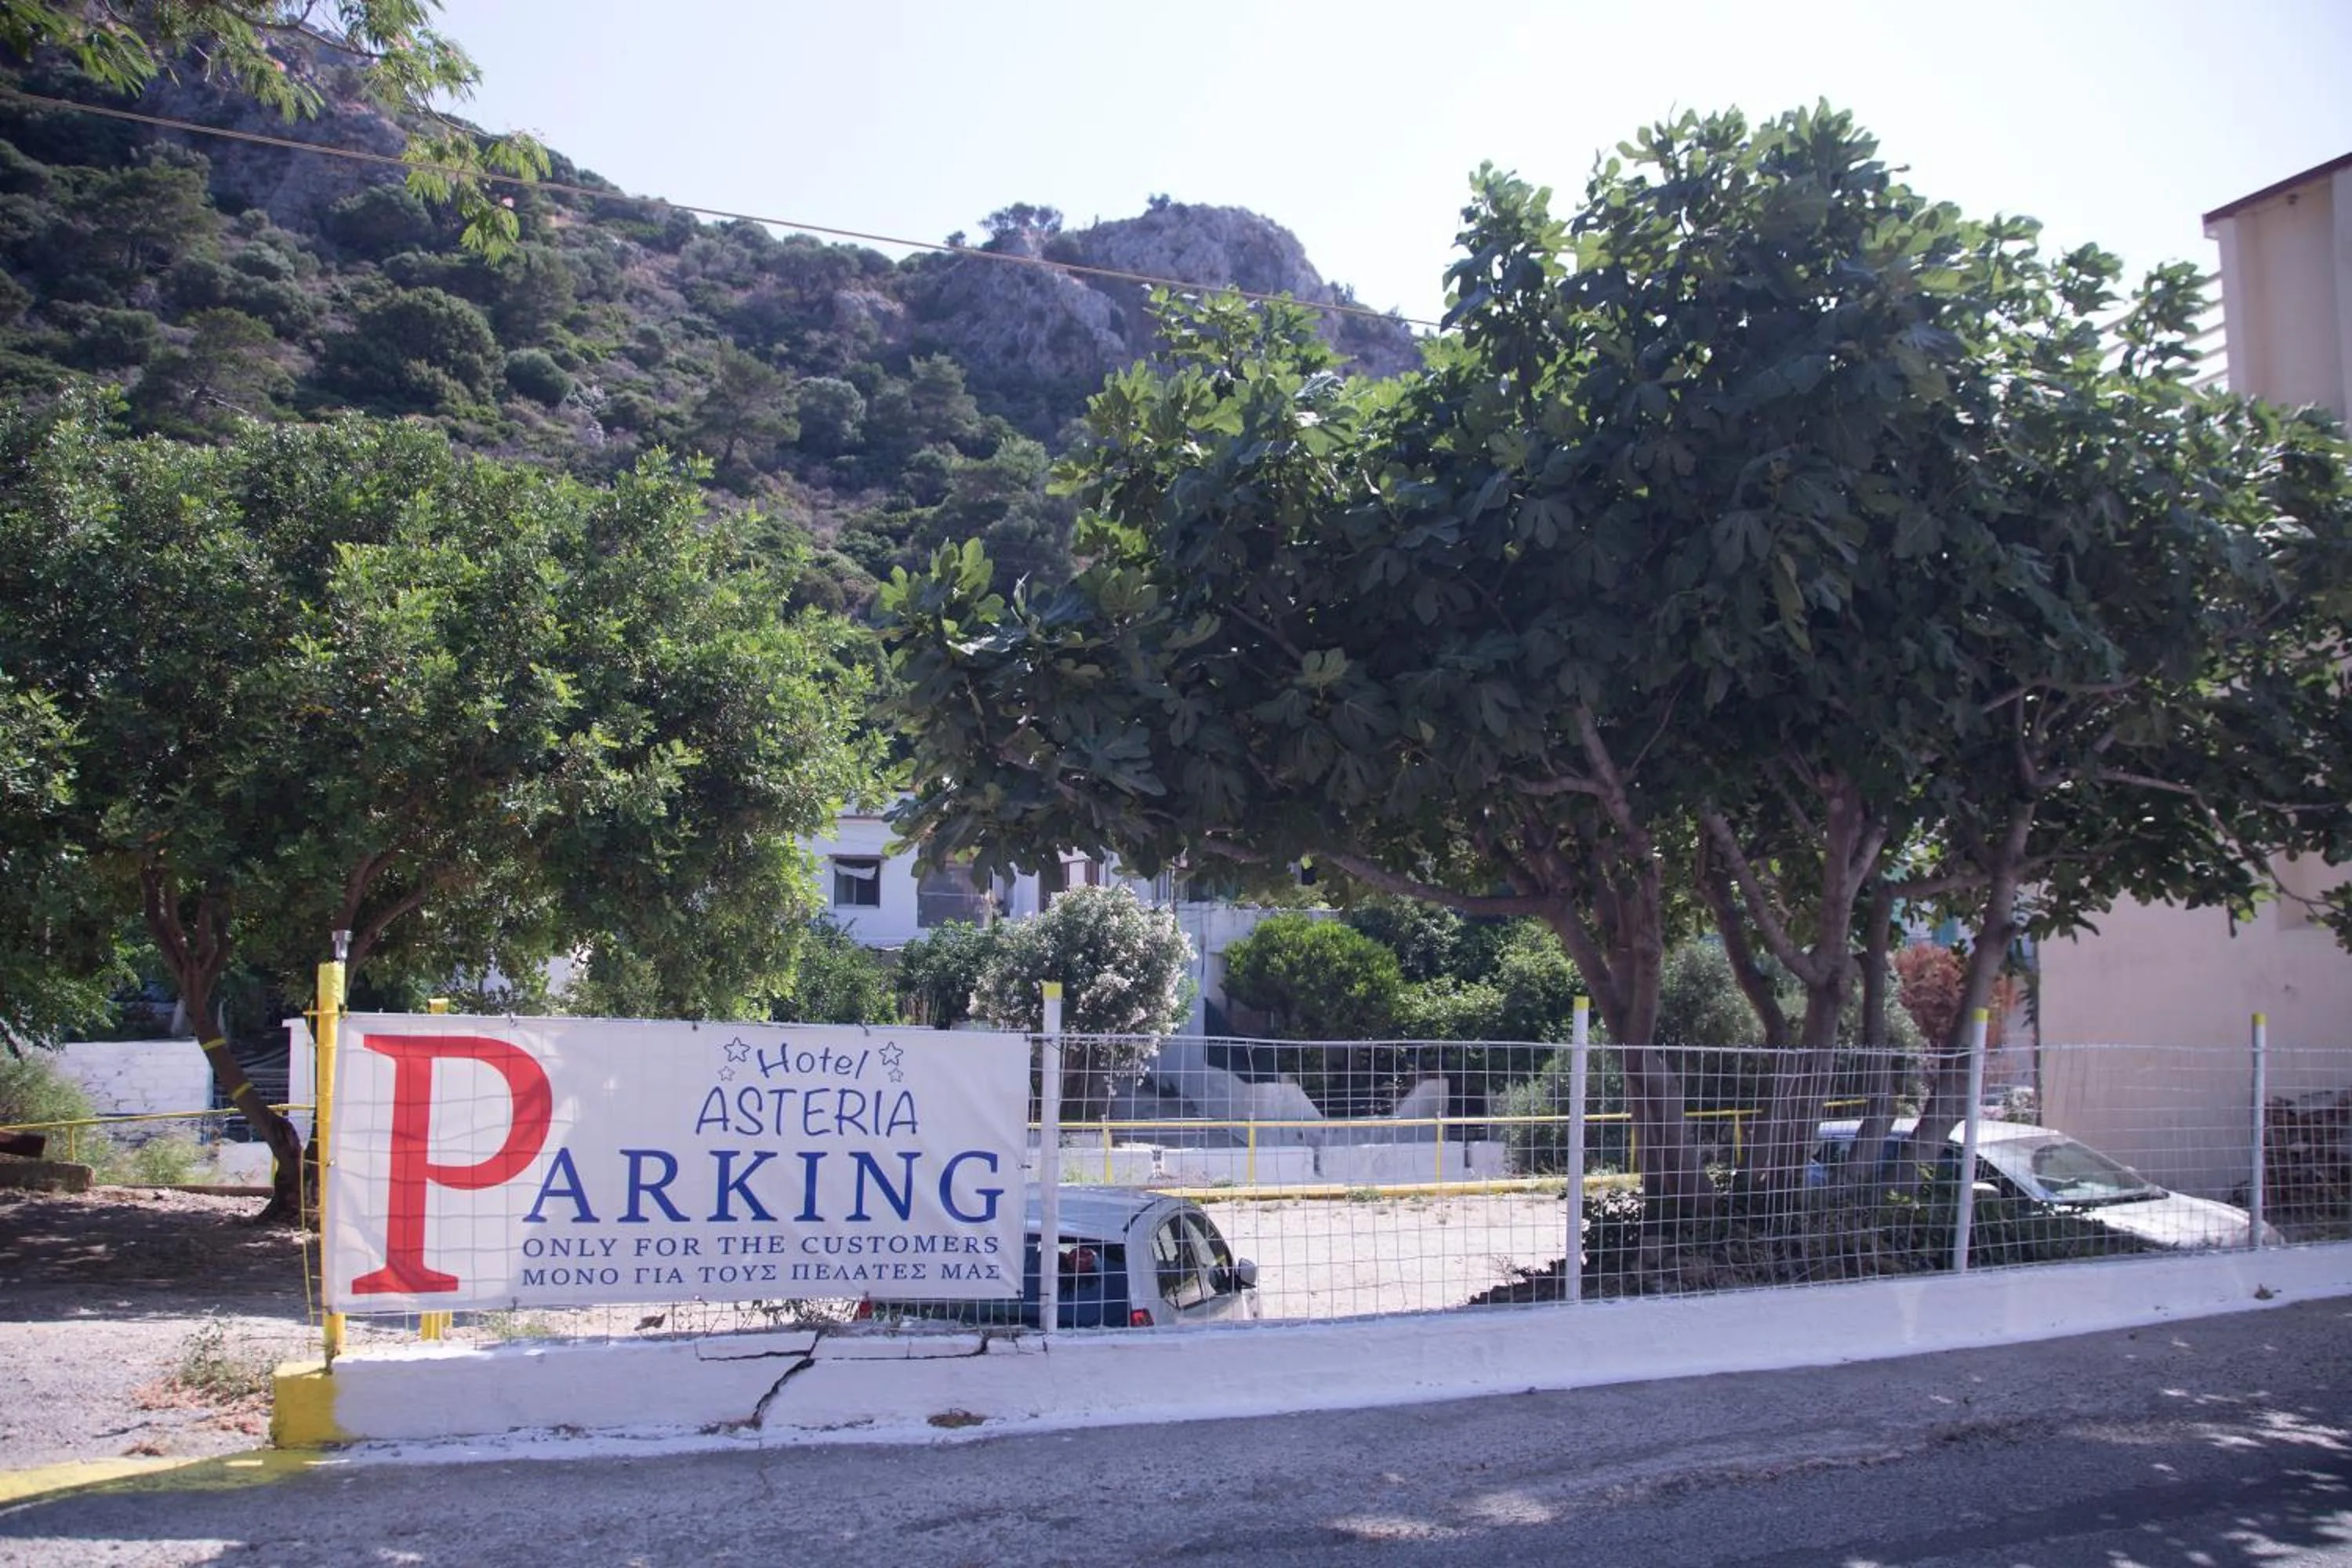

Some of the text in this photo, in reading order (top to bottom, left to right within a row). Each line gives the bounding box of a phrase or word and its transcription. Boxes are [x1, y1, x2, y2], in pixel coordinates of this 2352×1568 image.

[757, 1043, 869, 1079] Hotel
[695, 1086, 919, 1138] ASTERIA
[351, 1034, 1004, 1295] PARKING
[522, 1235, 999, 1257] ONLY FOR THE CUSTOMERS
[521, 1263, 1001, 1286] ΜΟΝΟ ΓΙΑ ΤΟΥΣ ΠΕΛΑΤΕΣ ΜΑΣ
